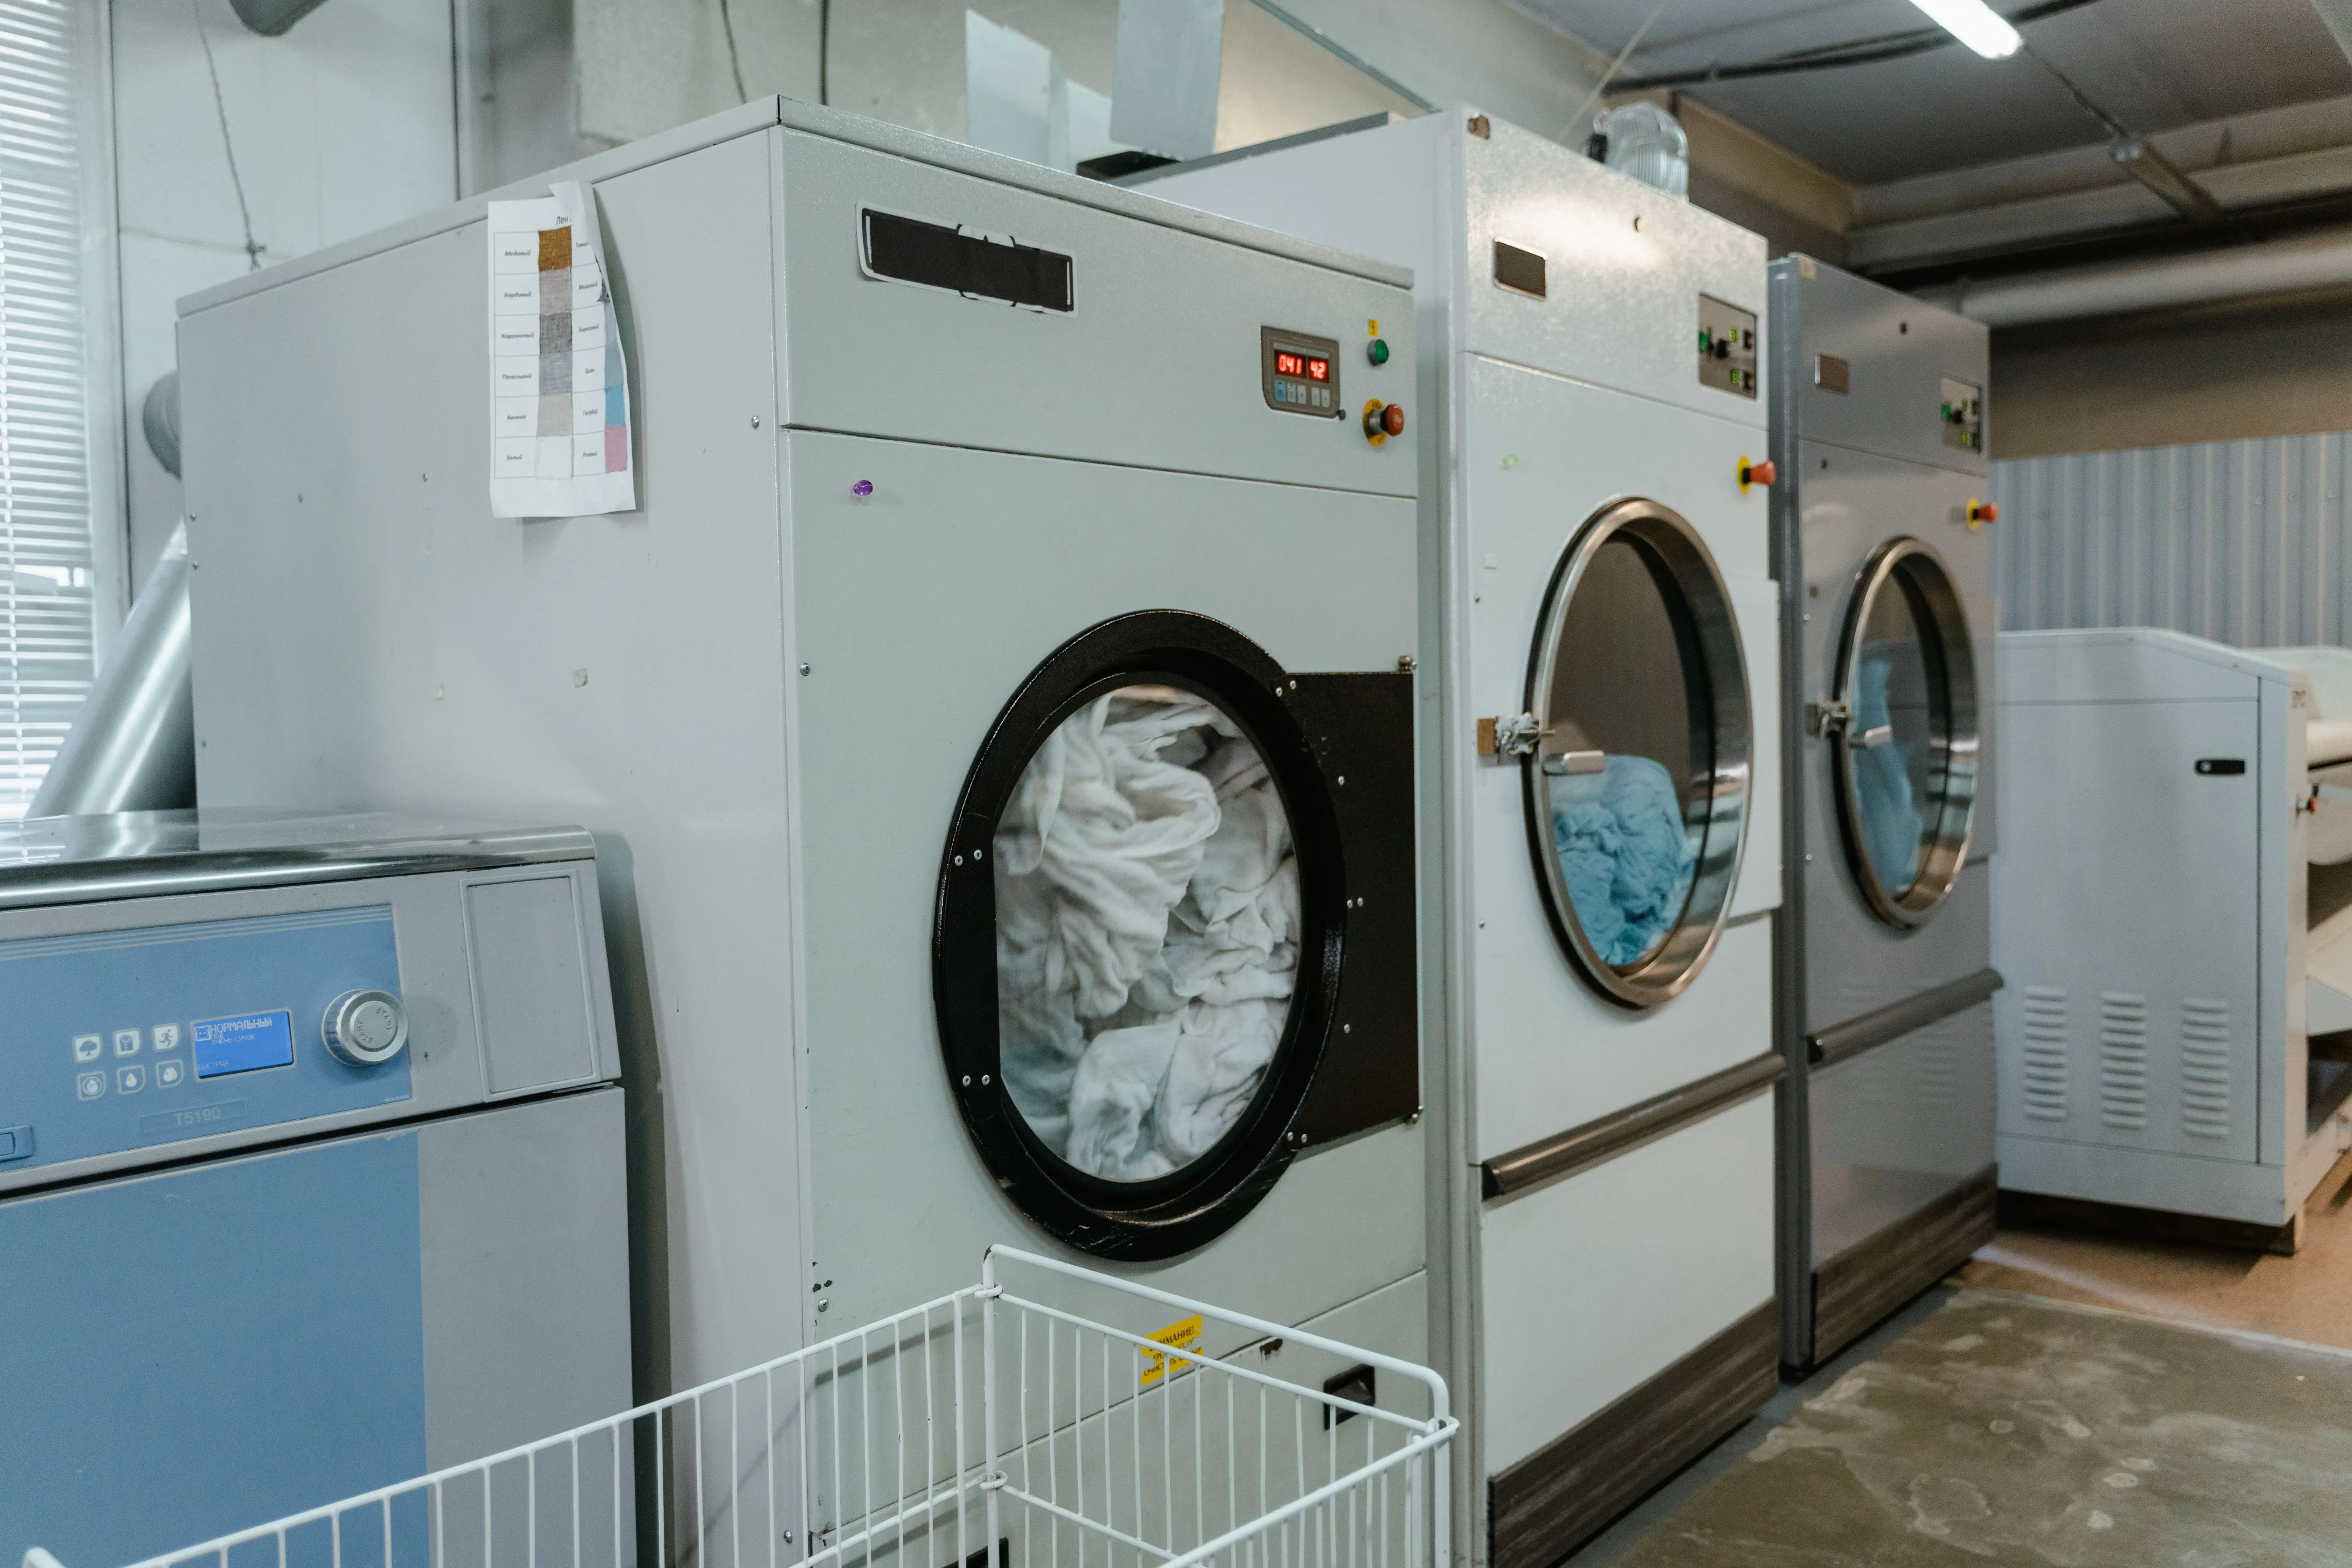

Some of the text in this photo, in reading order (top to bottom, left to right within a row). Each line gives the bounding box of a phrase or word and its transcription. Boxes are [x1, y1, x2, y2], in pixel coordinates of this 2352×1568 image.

[556, 216, 568, 225] Лен
[1279, 354, 1327, 379] 041 42
[210, 1017, 272, 1034] НОРМАЛЬНЫЙ
[376, 1008, 392, 1033] START
[234, 1034, 256, 1042] СУХОЕ
[357, 1020, 374, 1044] START
[198, 1060, 229, 1071] БЫСТРАЯ
[174, 1107, 221, 1125] T5190
